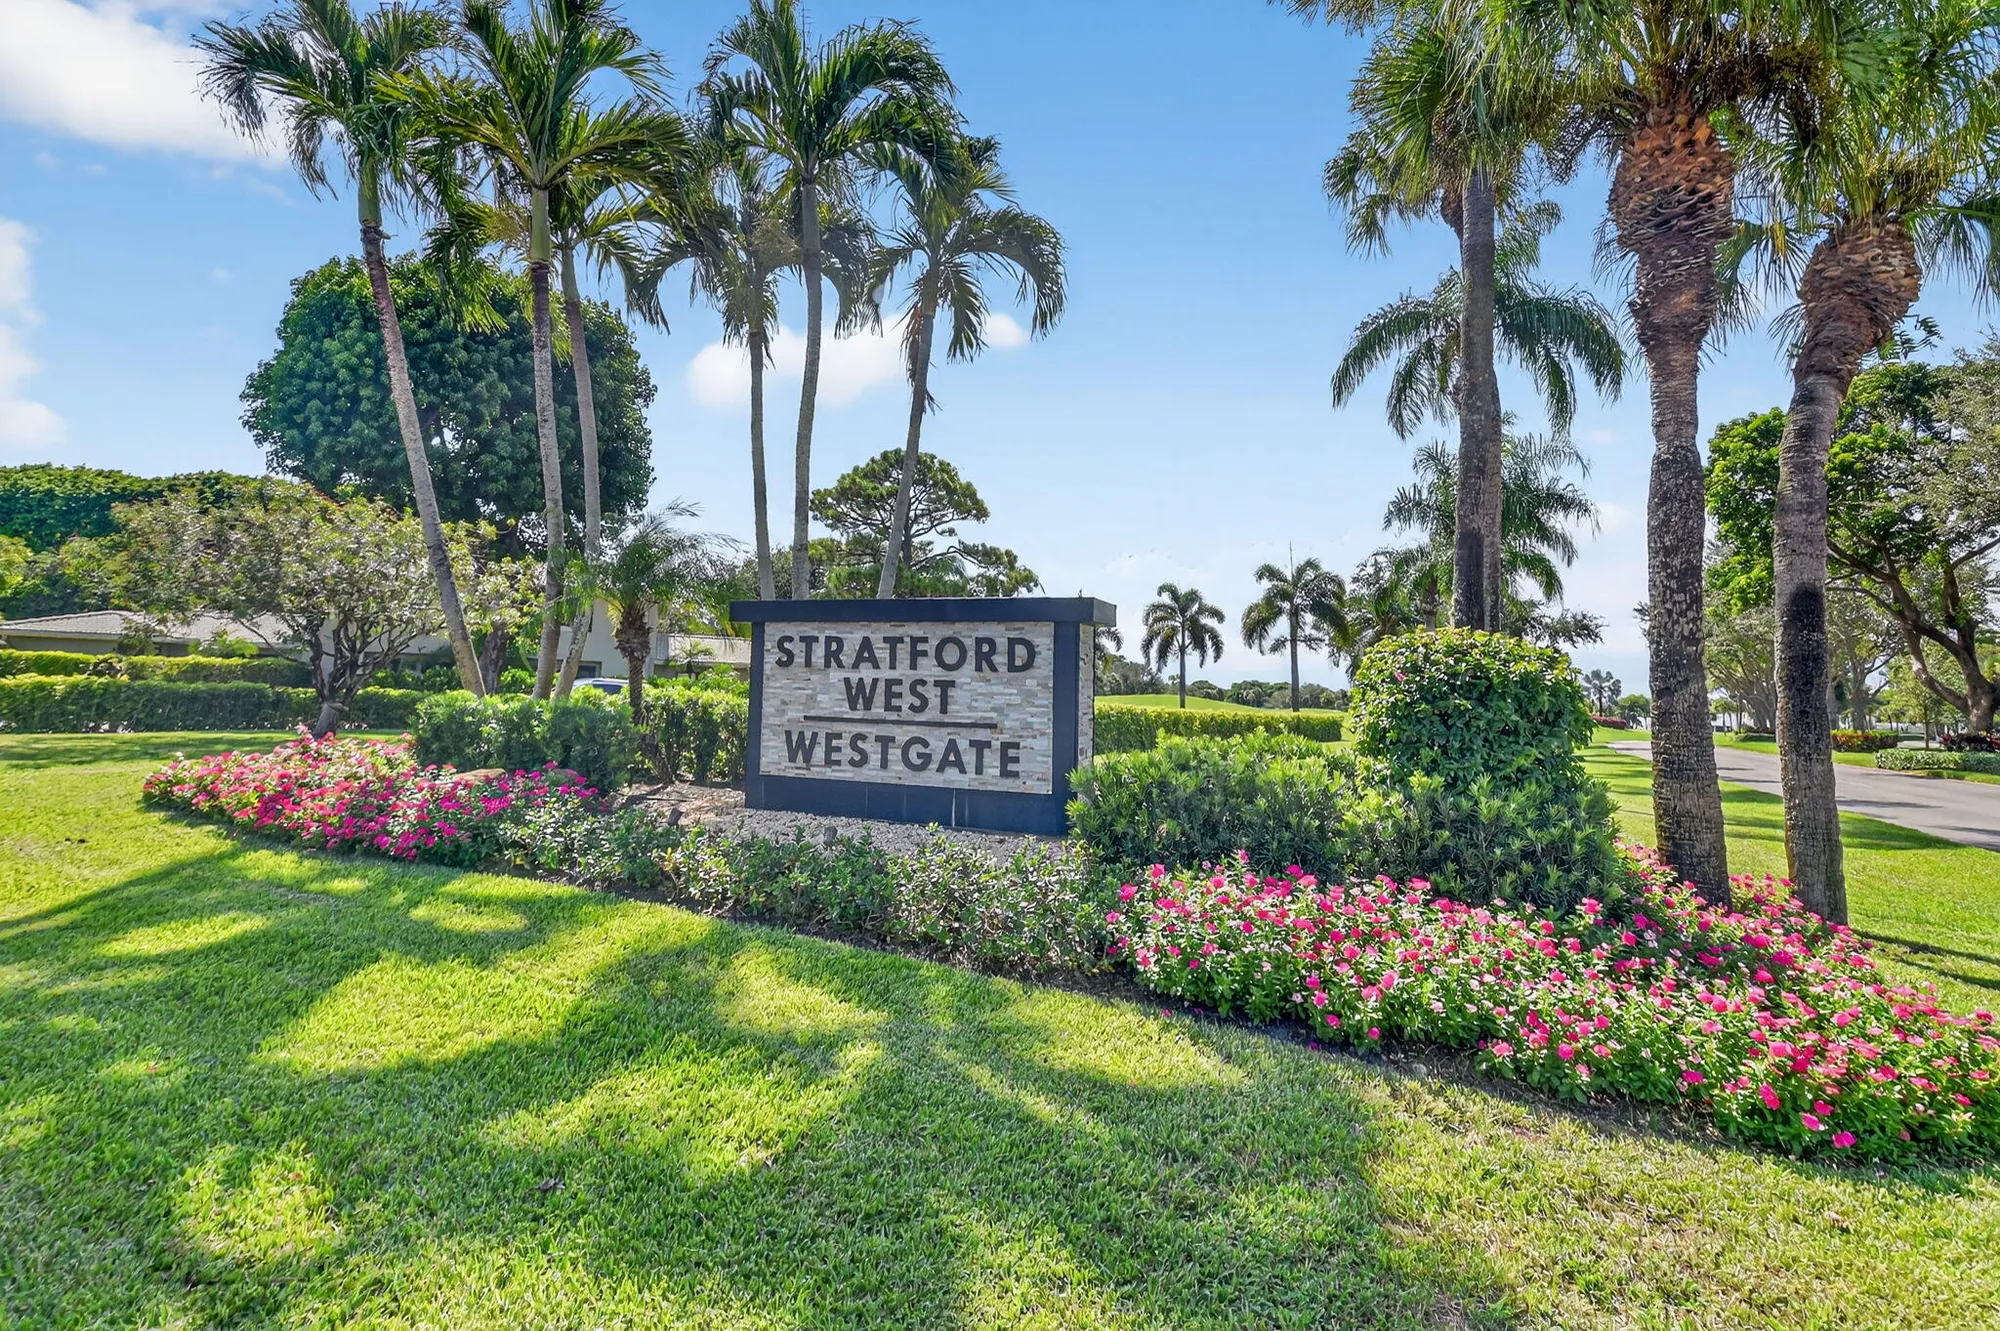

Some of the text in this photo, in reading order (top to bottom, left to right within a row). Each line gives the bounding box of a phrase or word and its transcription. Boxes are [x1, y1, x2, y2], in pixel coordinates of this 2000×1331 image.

[775, 635, 1036, 673] STRATFORD
[843, 677, 956, 714] WEST
[784, 730, 1021, 778] WESTGATE
